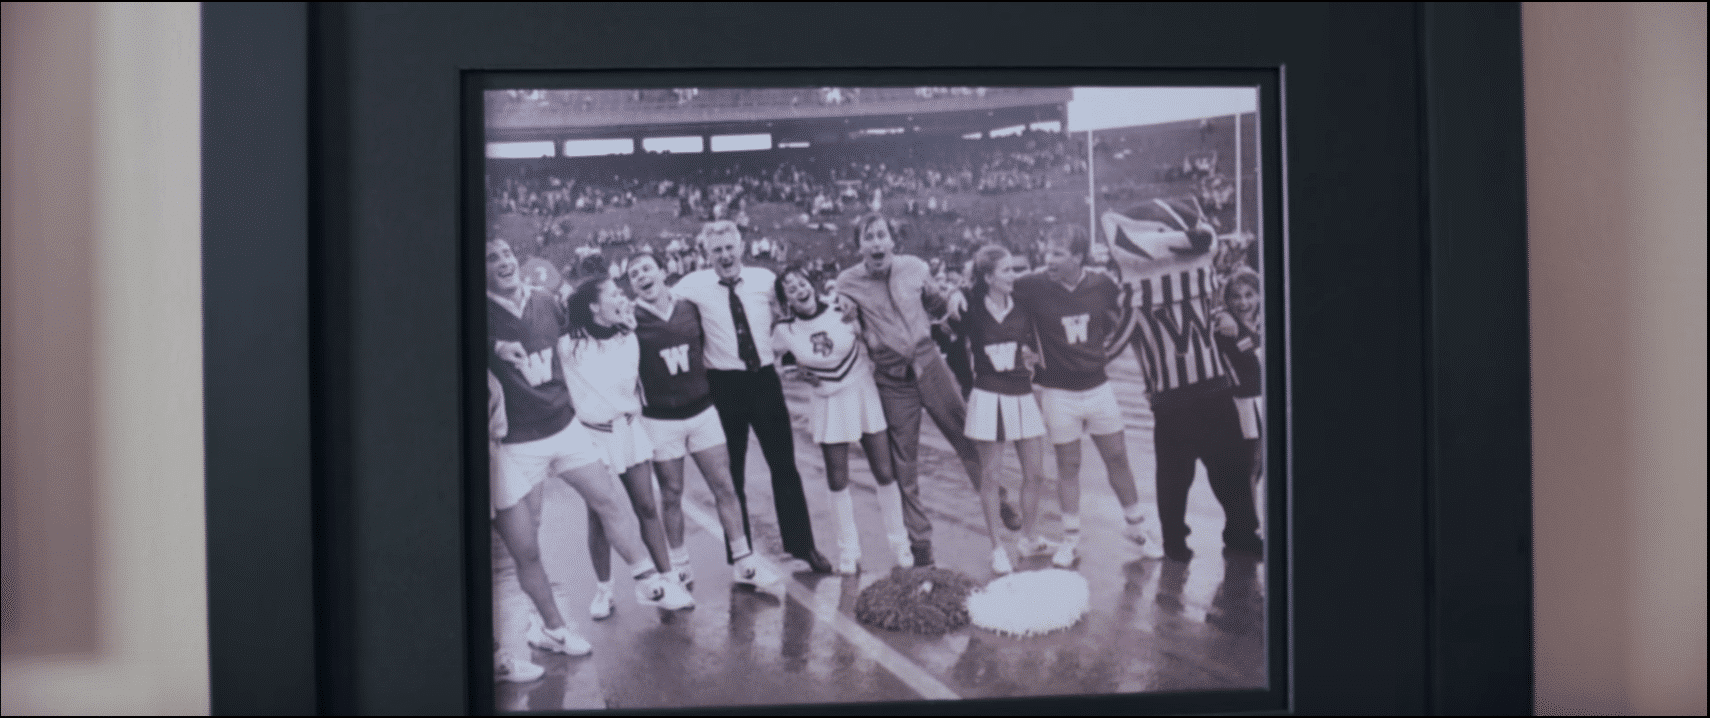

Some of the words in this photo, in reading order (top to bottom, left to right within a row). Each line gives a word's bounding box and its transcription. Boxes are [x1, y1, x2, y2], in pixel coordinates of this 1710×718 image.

[1061, 313, 1090, 345] W
[519, 346, 553, 387] W
[659, 343, 690, 376] W
[984, 341, 1018, 372] W
